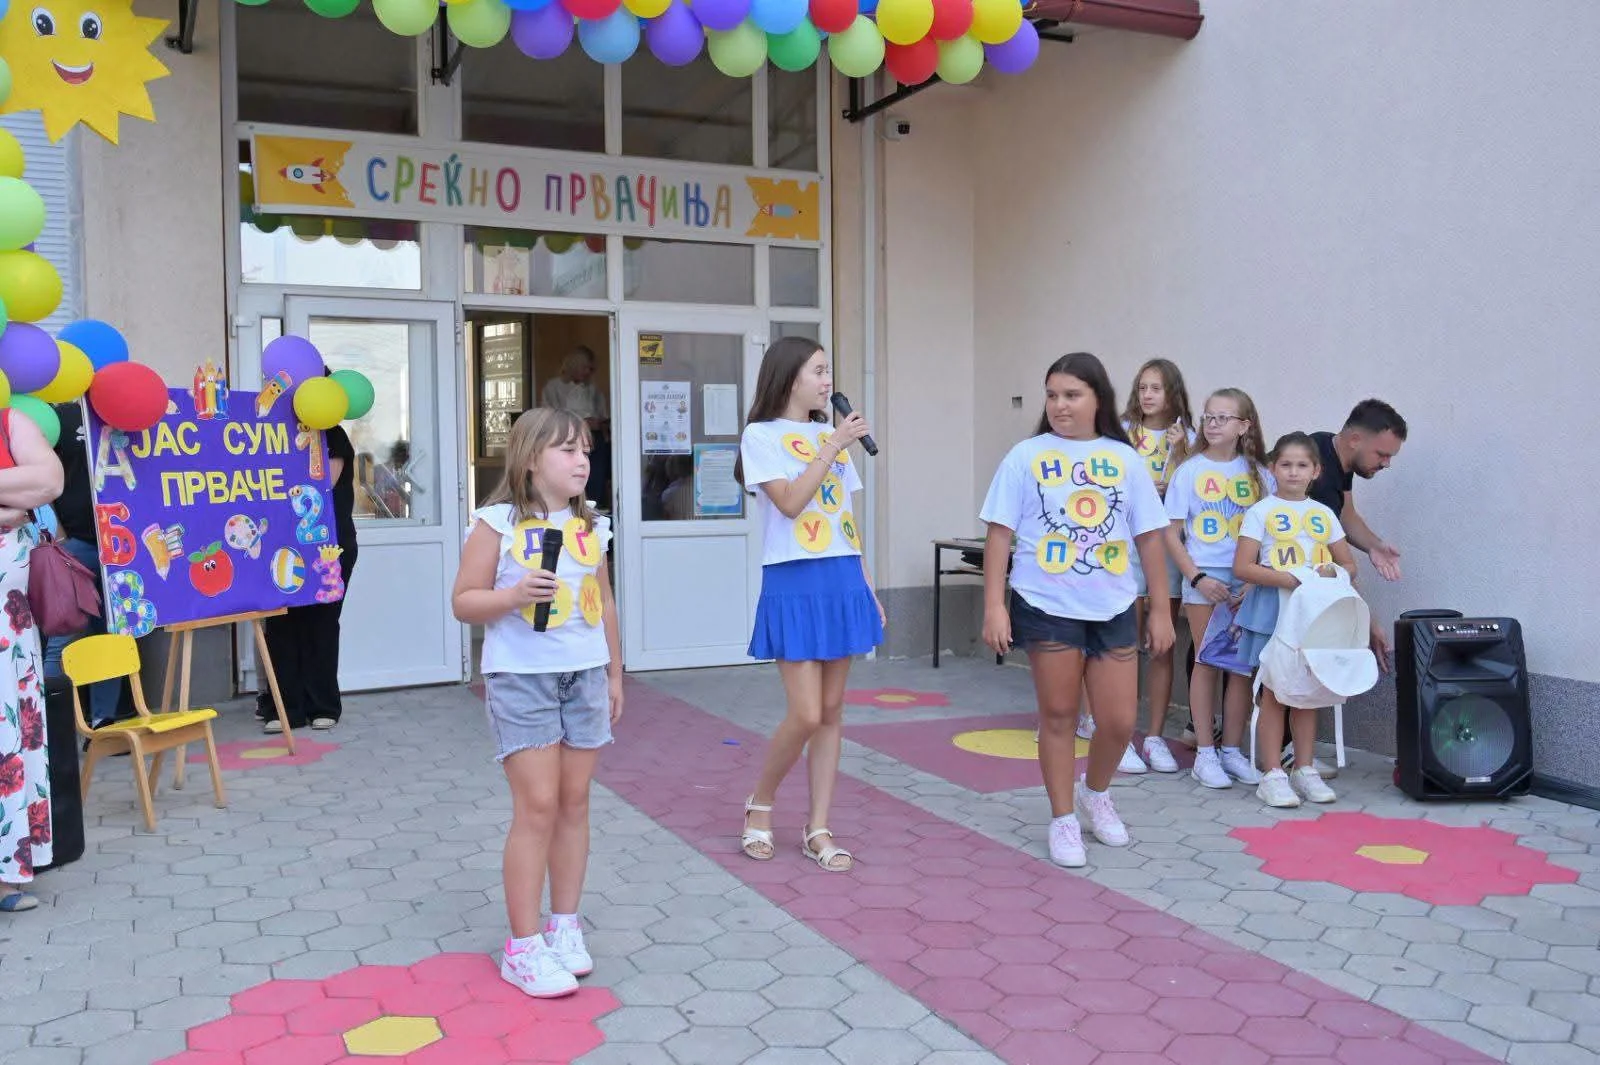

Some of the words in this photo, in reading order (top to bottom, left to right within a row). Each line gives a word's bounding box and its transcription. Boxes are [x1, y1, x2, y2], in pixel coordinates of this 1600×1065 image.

[366, 153, 521, 212] СРЕЌНО
[545, 172, 732, 229] ПРВАЧИЊА
[223, 421, 290, 455] СУМ
[1040, 459, 1062, 480] Н
[1090, 457, 1118, 478] Њ
[160, 468, 287, 506] ПРВАЧЕ
[1204, 478, 1221, 495] А
[1235, 480, 1250, 498] Б
[1203, 518, 1218, 535] В
[1046, 541, 1067, 563] П
